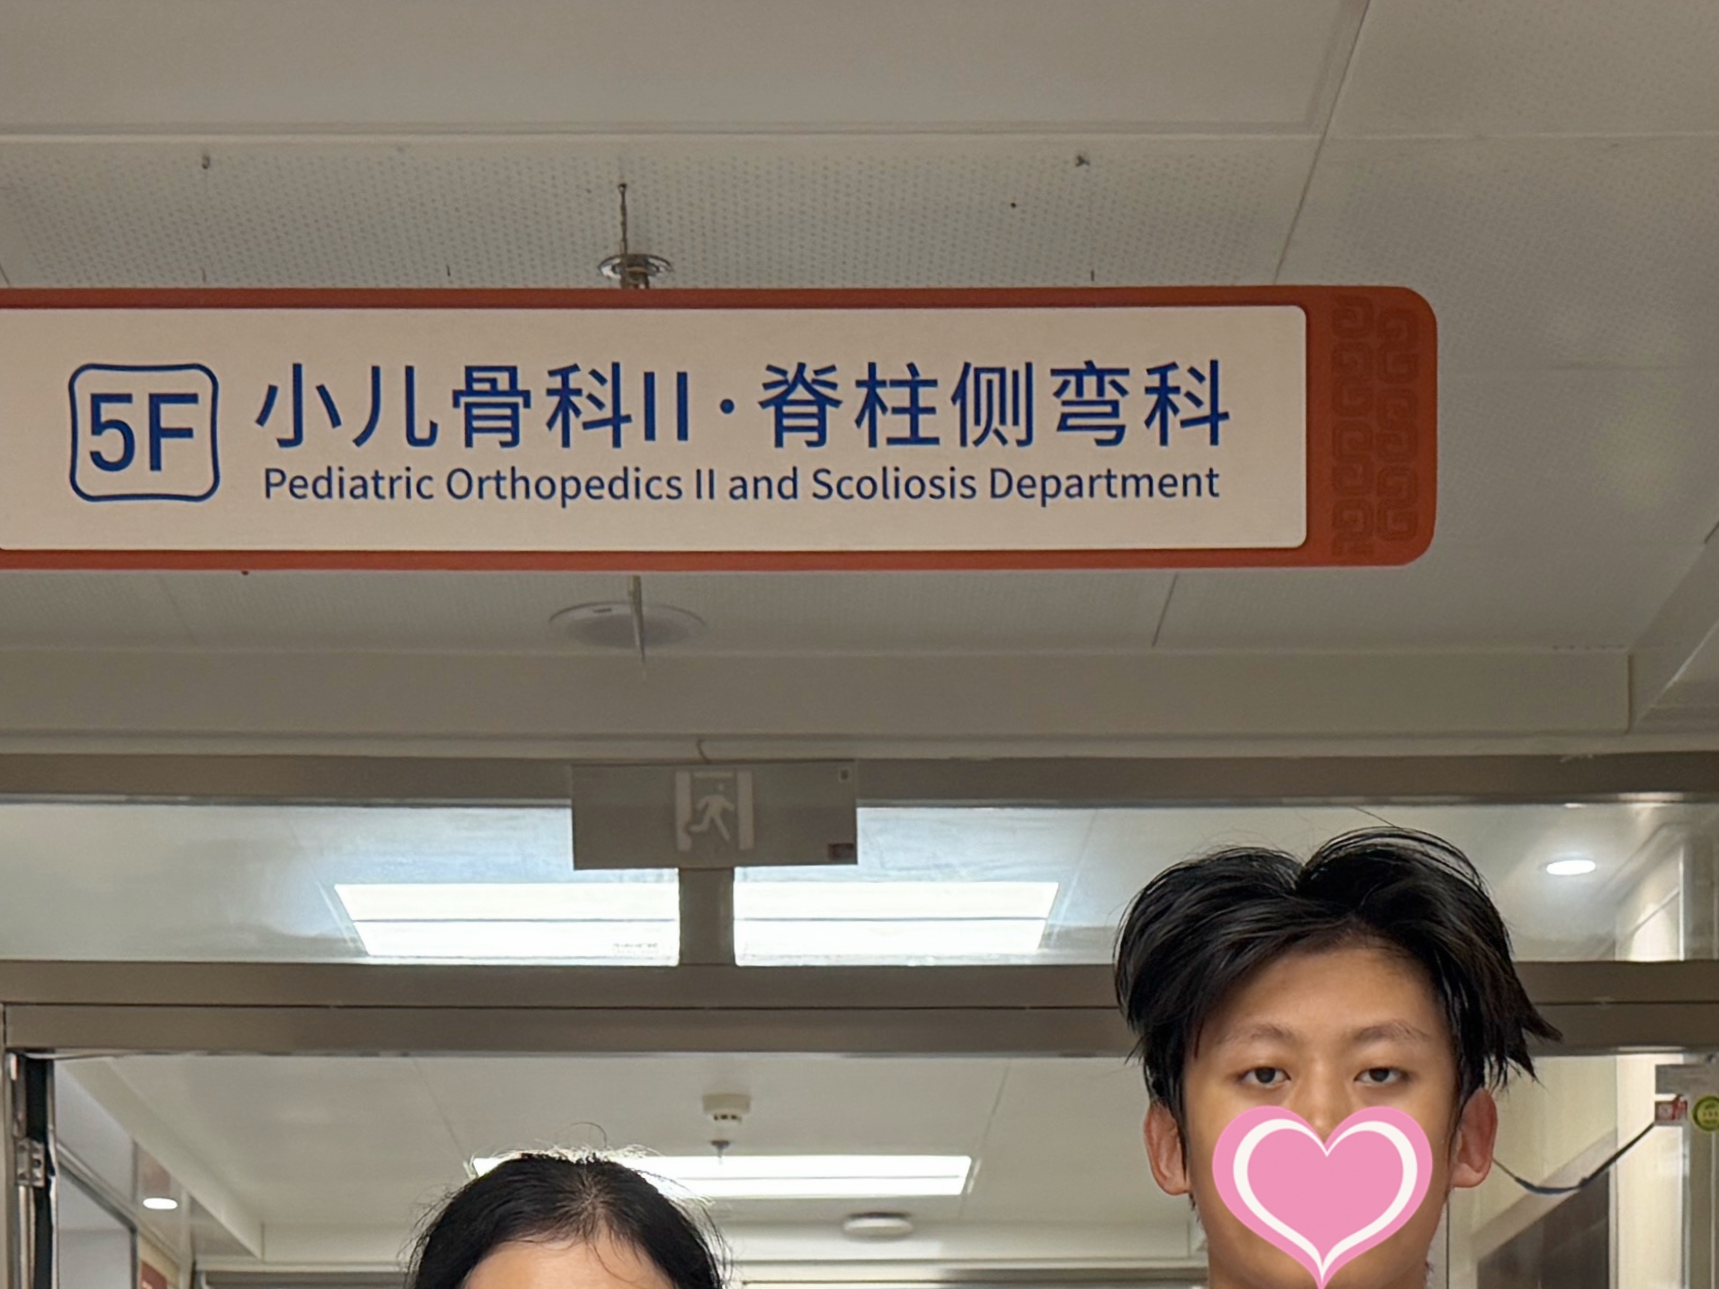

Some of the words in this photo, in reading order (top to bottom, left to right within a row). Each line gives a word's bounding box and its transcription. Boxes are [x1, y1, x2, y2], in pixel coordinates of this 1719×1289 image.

[89, 392, 199, 472] 5F
[263, 465, 435, 501] Pediatric
[446, 465, 683, 508] Orthopedics
[728, 465, 800, 501] and
[811, 465, 978, 501] Scoliosis
[989, 465, 1221, 508] Department
